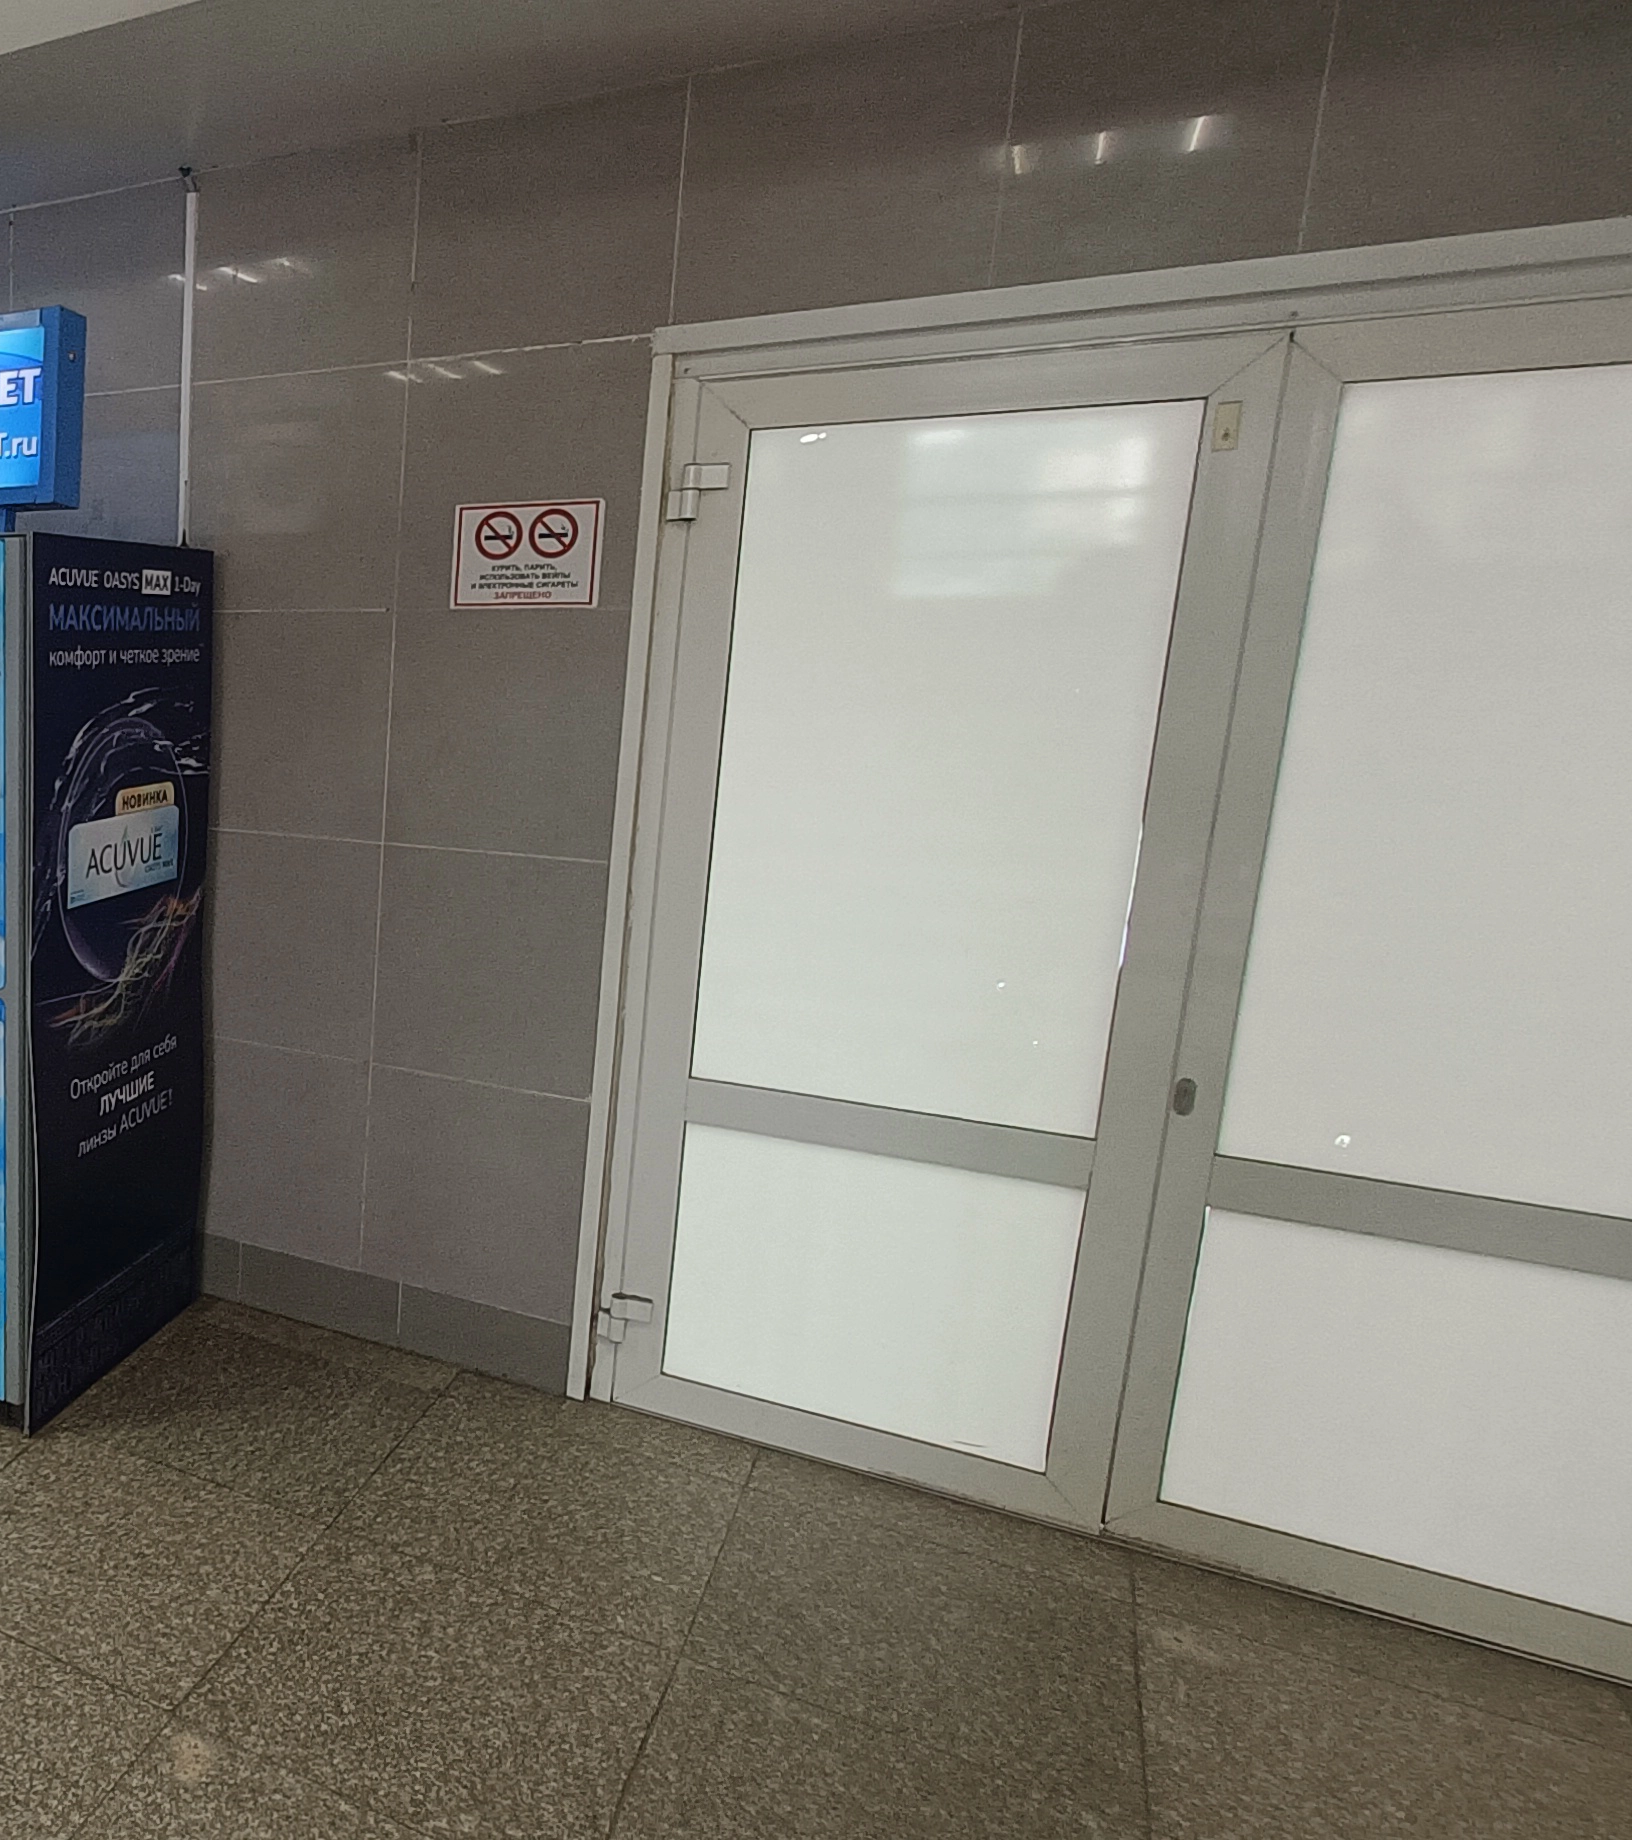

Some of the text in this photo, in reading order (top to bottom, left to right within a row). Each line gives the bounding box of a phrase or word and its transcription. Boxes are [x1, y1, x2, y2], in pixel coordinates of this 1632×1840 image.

[479, 571, 571, 581] ИСПОЛЬЗОВАТЬ ВЕЙПЫ
[491, 564, 522, 572] КУРИТЬ,
[48, 567, 202, 597] ACUVUE OASYS MAX 1-Day
[470, 580, 580, 590] И ЭЛЕКТРОННЫЕ СИГАРЕТЫ
[493, 591, 553, 600] ЗАПРЕЩЕНО
[48, 602, 201, 632] МАКСИМАЛЬНЫЙ
[49, 645, 201, 670] комфорт и четкое зрение
[121, 789, 169, 811] НОВИНКА
[85, 832, 164, 879] ACUVUE
[70, 1033, 178, 1100] Откройте для себя
[99, 1070, 155, 1117] ЛУЧШИЕ
[77, 1123, 118, 1158] линзы
